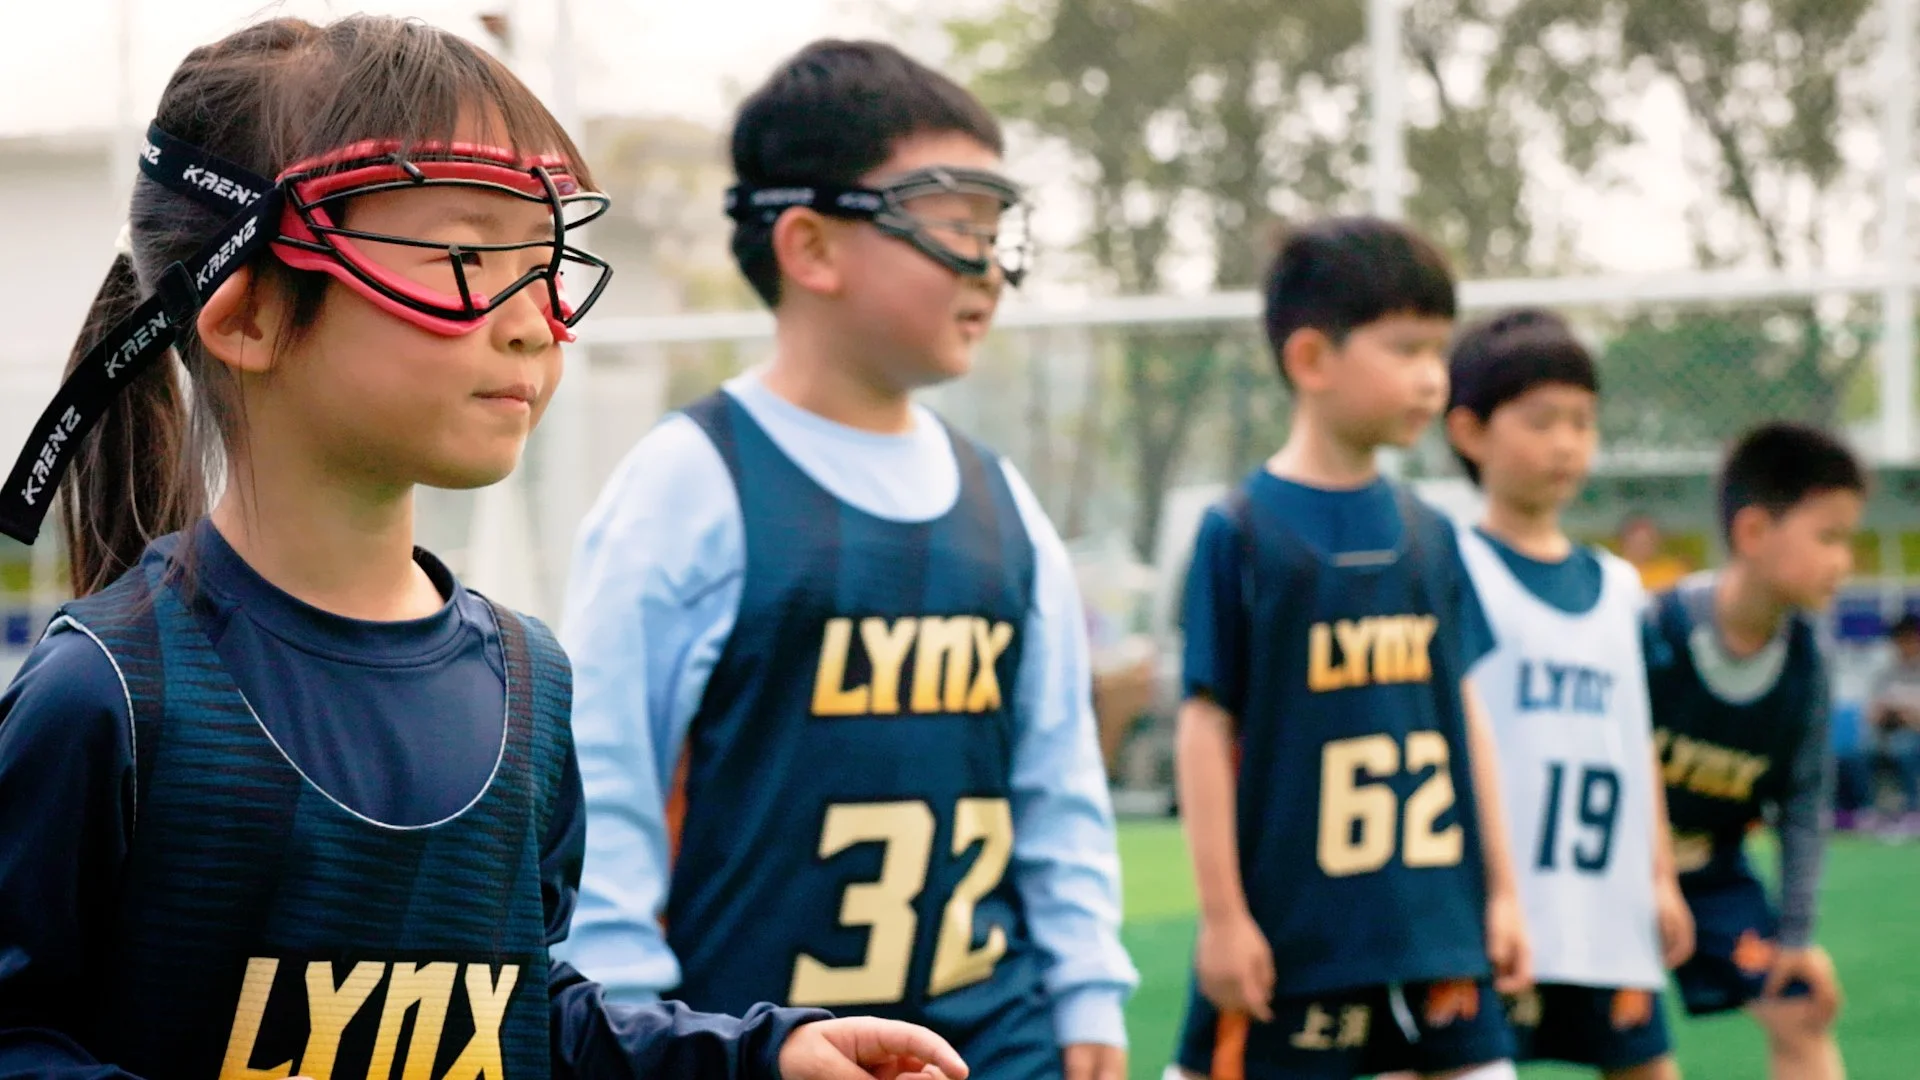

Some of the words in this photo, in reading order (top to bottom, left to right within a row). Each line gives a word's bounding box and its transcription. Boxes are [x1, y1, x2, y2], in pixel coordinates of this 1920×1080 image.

[105, 309, 172, 379] KREN
[810, 615, 1014, 717] LYNX
[1307, 613, 1439, 692] LYNX
[1316, 730, 1464, 878] 62
[1535, 760, 1624, 876] 19
[787, 797, 1014, 1007] 32
[217, 956, 520, 1080] LYNX
